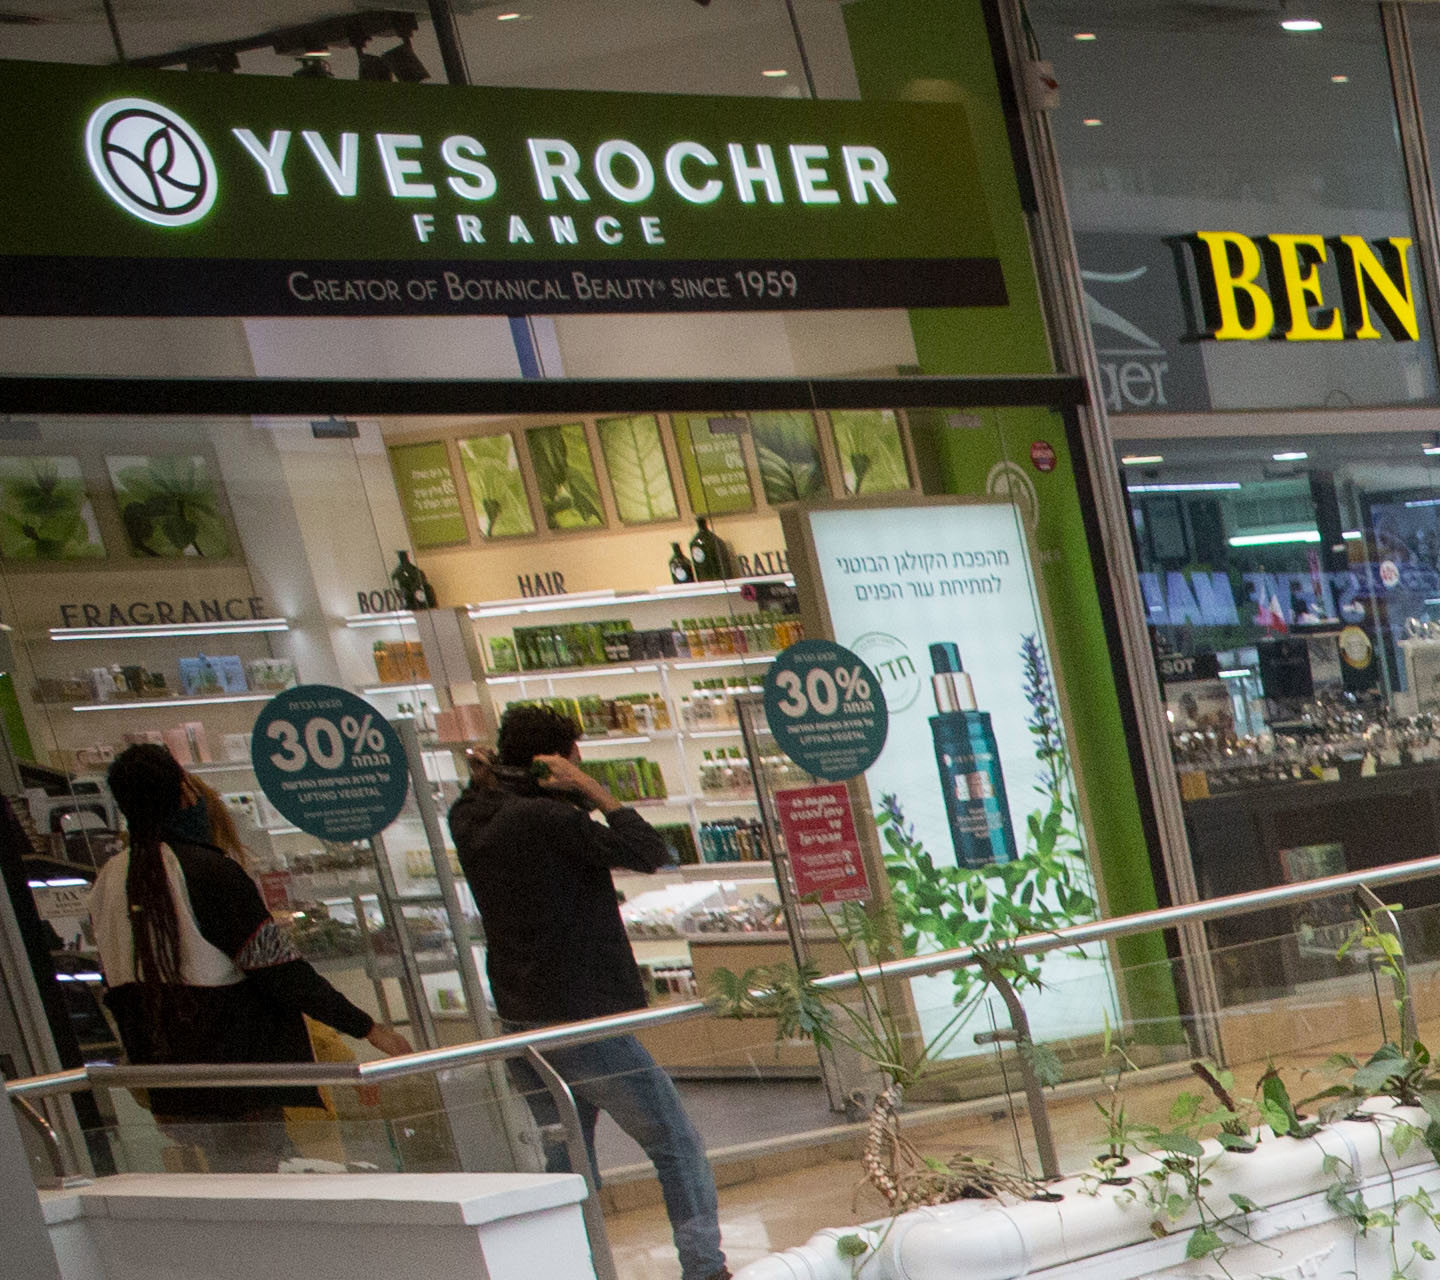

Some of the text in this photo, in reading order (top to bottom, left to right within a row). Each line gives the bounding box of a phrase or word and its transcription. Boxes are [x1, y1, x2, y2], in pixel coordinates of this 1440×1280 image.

[232, 128, 898, 204] YVES ROCHER
[413, 213, 666, 245] FRANCE
[289, 271, 401, 302] CREATOR
[407, 280, 438, 302] OF
[444, 271, 570, 302] BOTANICAL
[672, 277, 731, 299] SINCE
[734, 270, 798, 299] 1959
[1190, 231, 1420, 341] BEN
[836, 549, 1010, 577] מהפכת הקולגן הבוטני
[517, 571, 568, 598] HAIR
[855, 573, 1002, 601] למתיחת עור הפנים
[60, 596, 267, 628] FRAGRANCE
[776, 665, 871, 718] 30%
[266, 714, 385, 772] 30%
[351, 753, 391, 768] הנחה
